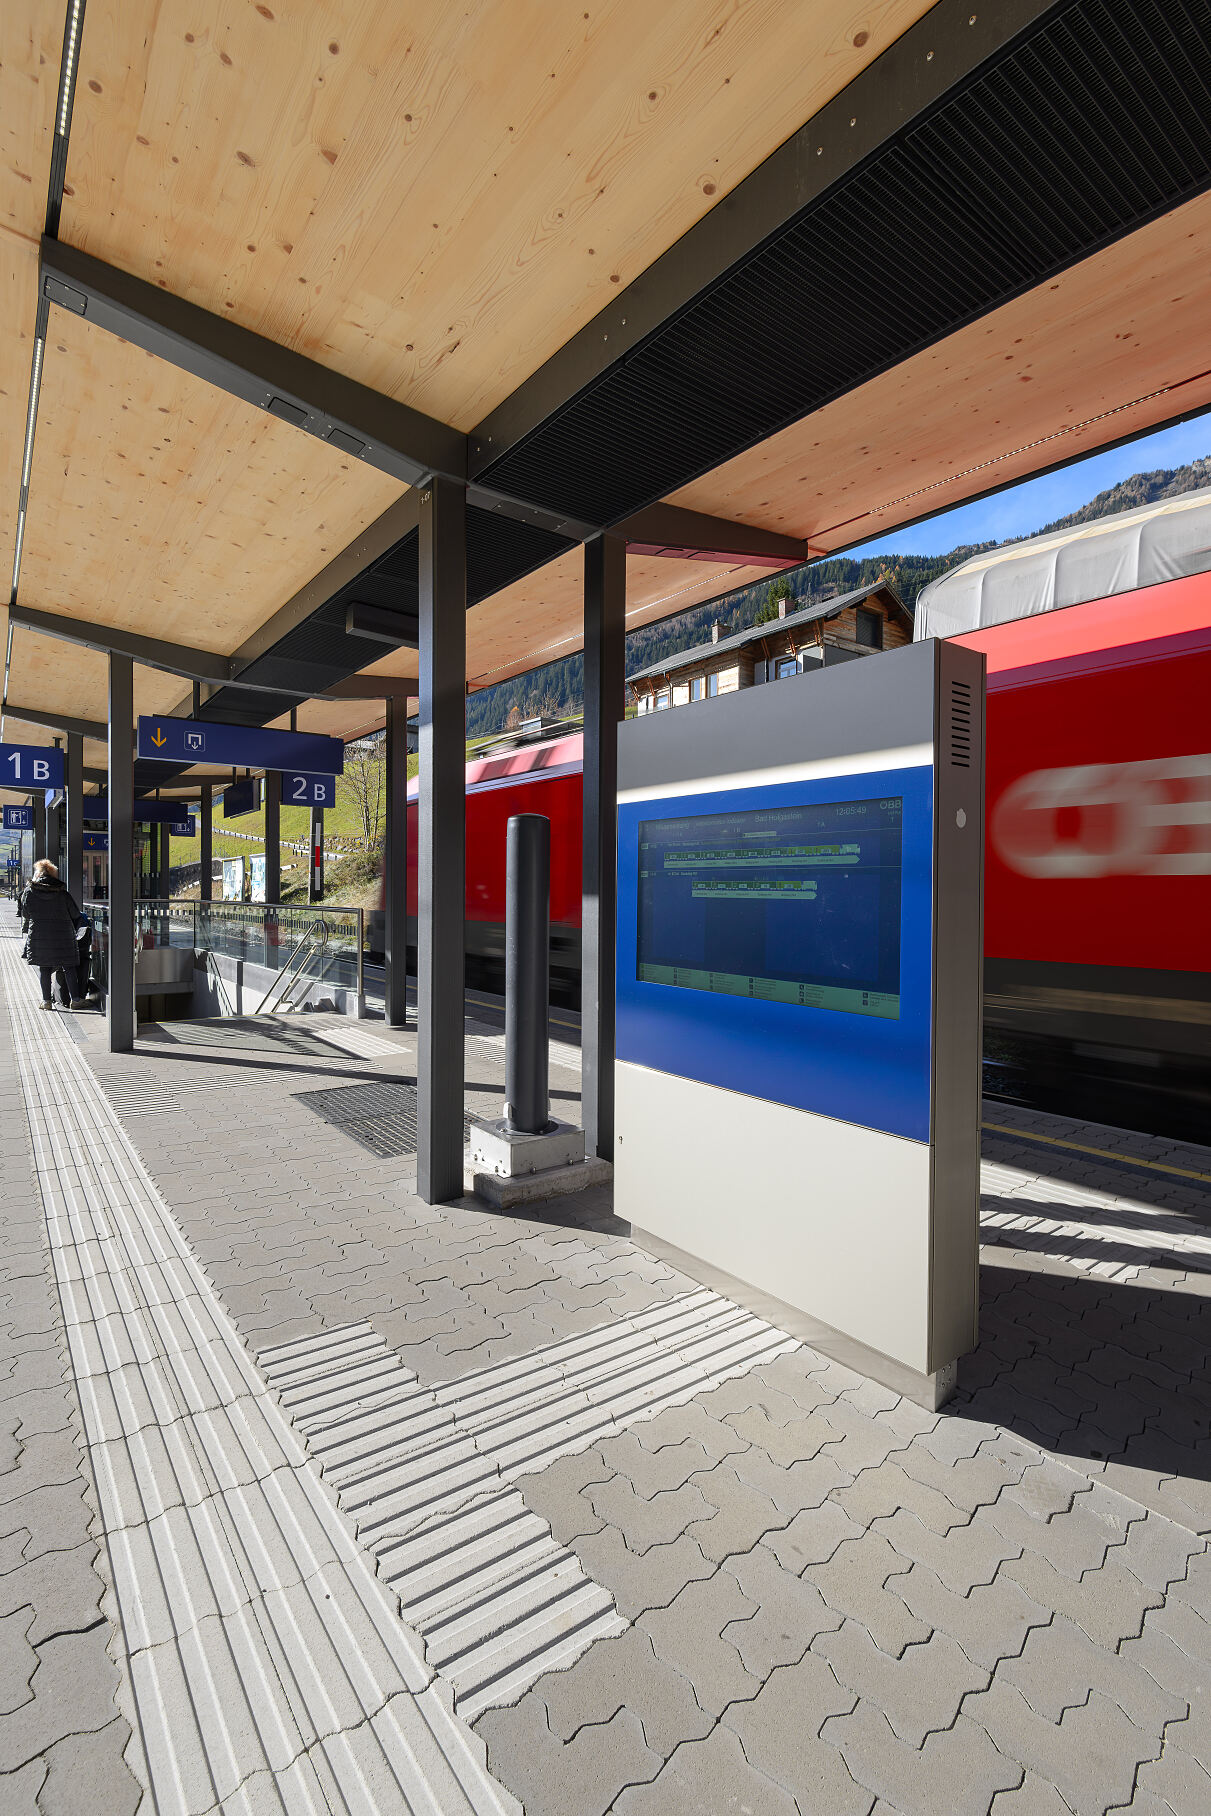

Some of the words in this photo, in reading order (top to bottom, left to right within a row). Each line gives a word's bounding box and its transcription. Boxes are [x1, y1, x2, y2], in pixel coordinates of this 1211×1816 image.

[7, 752, 21, 779] 1
[33, 759, 50, 780] B
[292, 776, 308, 800] 2
[313, 783, 326, 801] B
[879, 800, 902, 810] ÖBB
